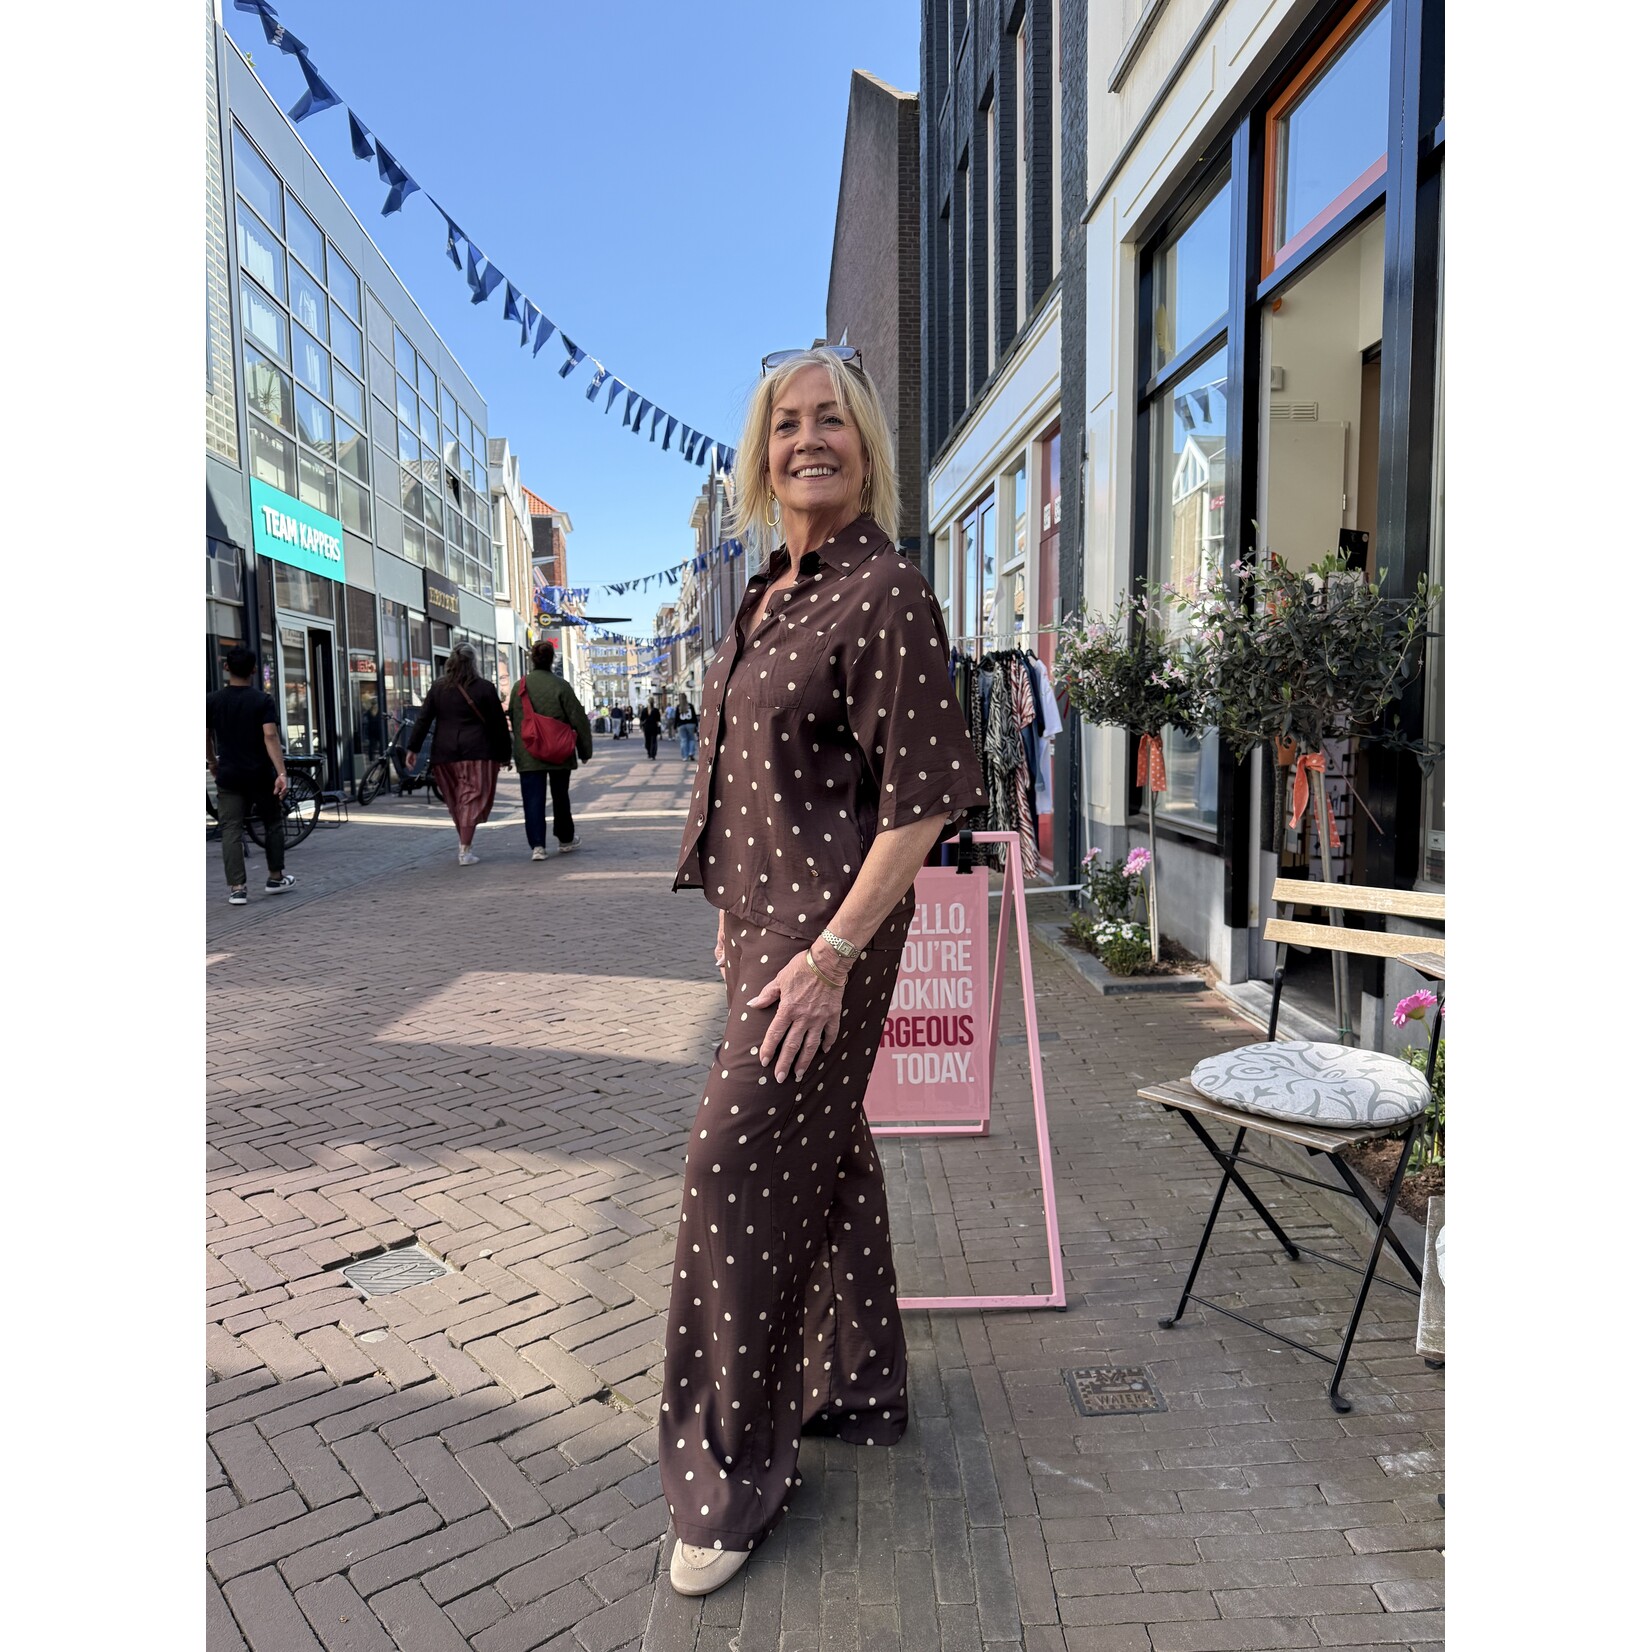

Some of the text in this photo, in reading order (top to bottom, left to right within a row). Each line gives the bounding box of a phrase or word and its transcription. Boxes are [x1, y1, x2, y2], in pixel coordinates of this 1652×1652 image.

[262, 505, 340, 562] TEAM KAPPERS
[908, 903, 972, 935] ELLO.
[901, 940, 972, 973] OU'RE
[888, 977, 973, 1011] OKING
[880, 1014, 974, 1048] RGEOUS
[892, 1052, 975, 1085] TODAY.
[1096, 1393, 1145, 1404] WATER
